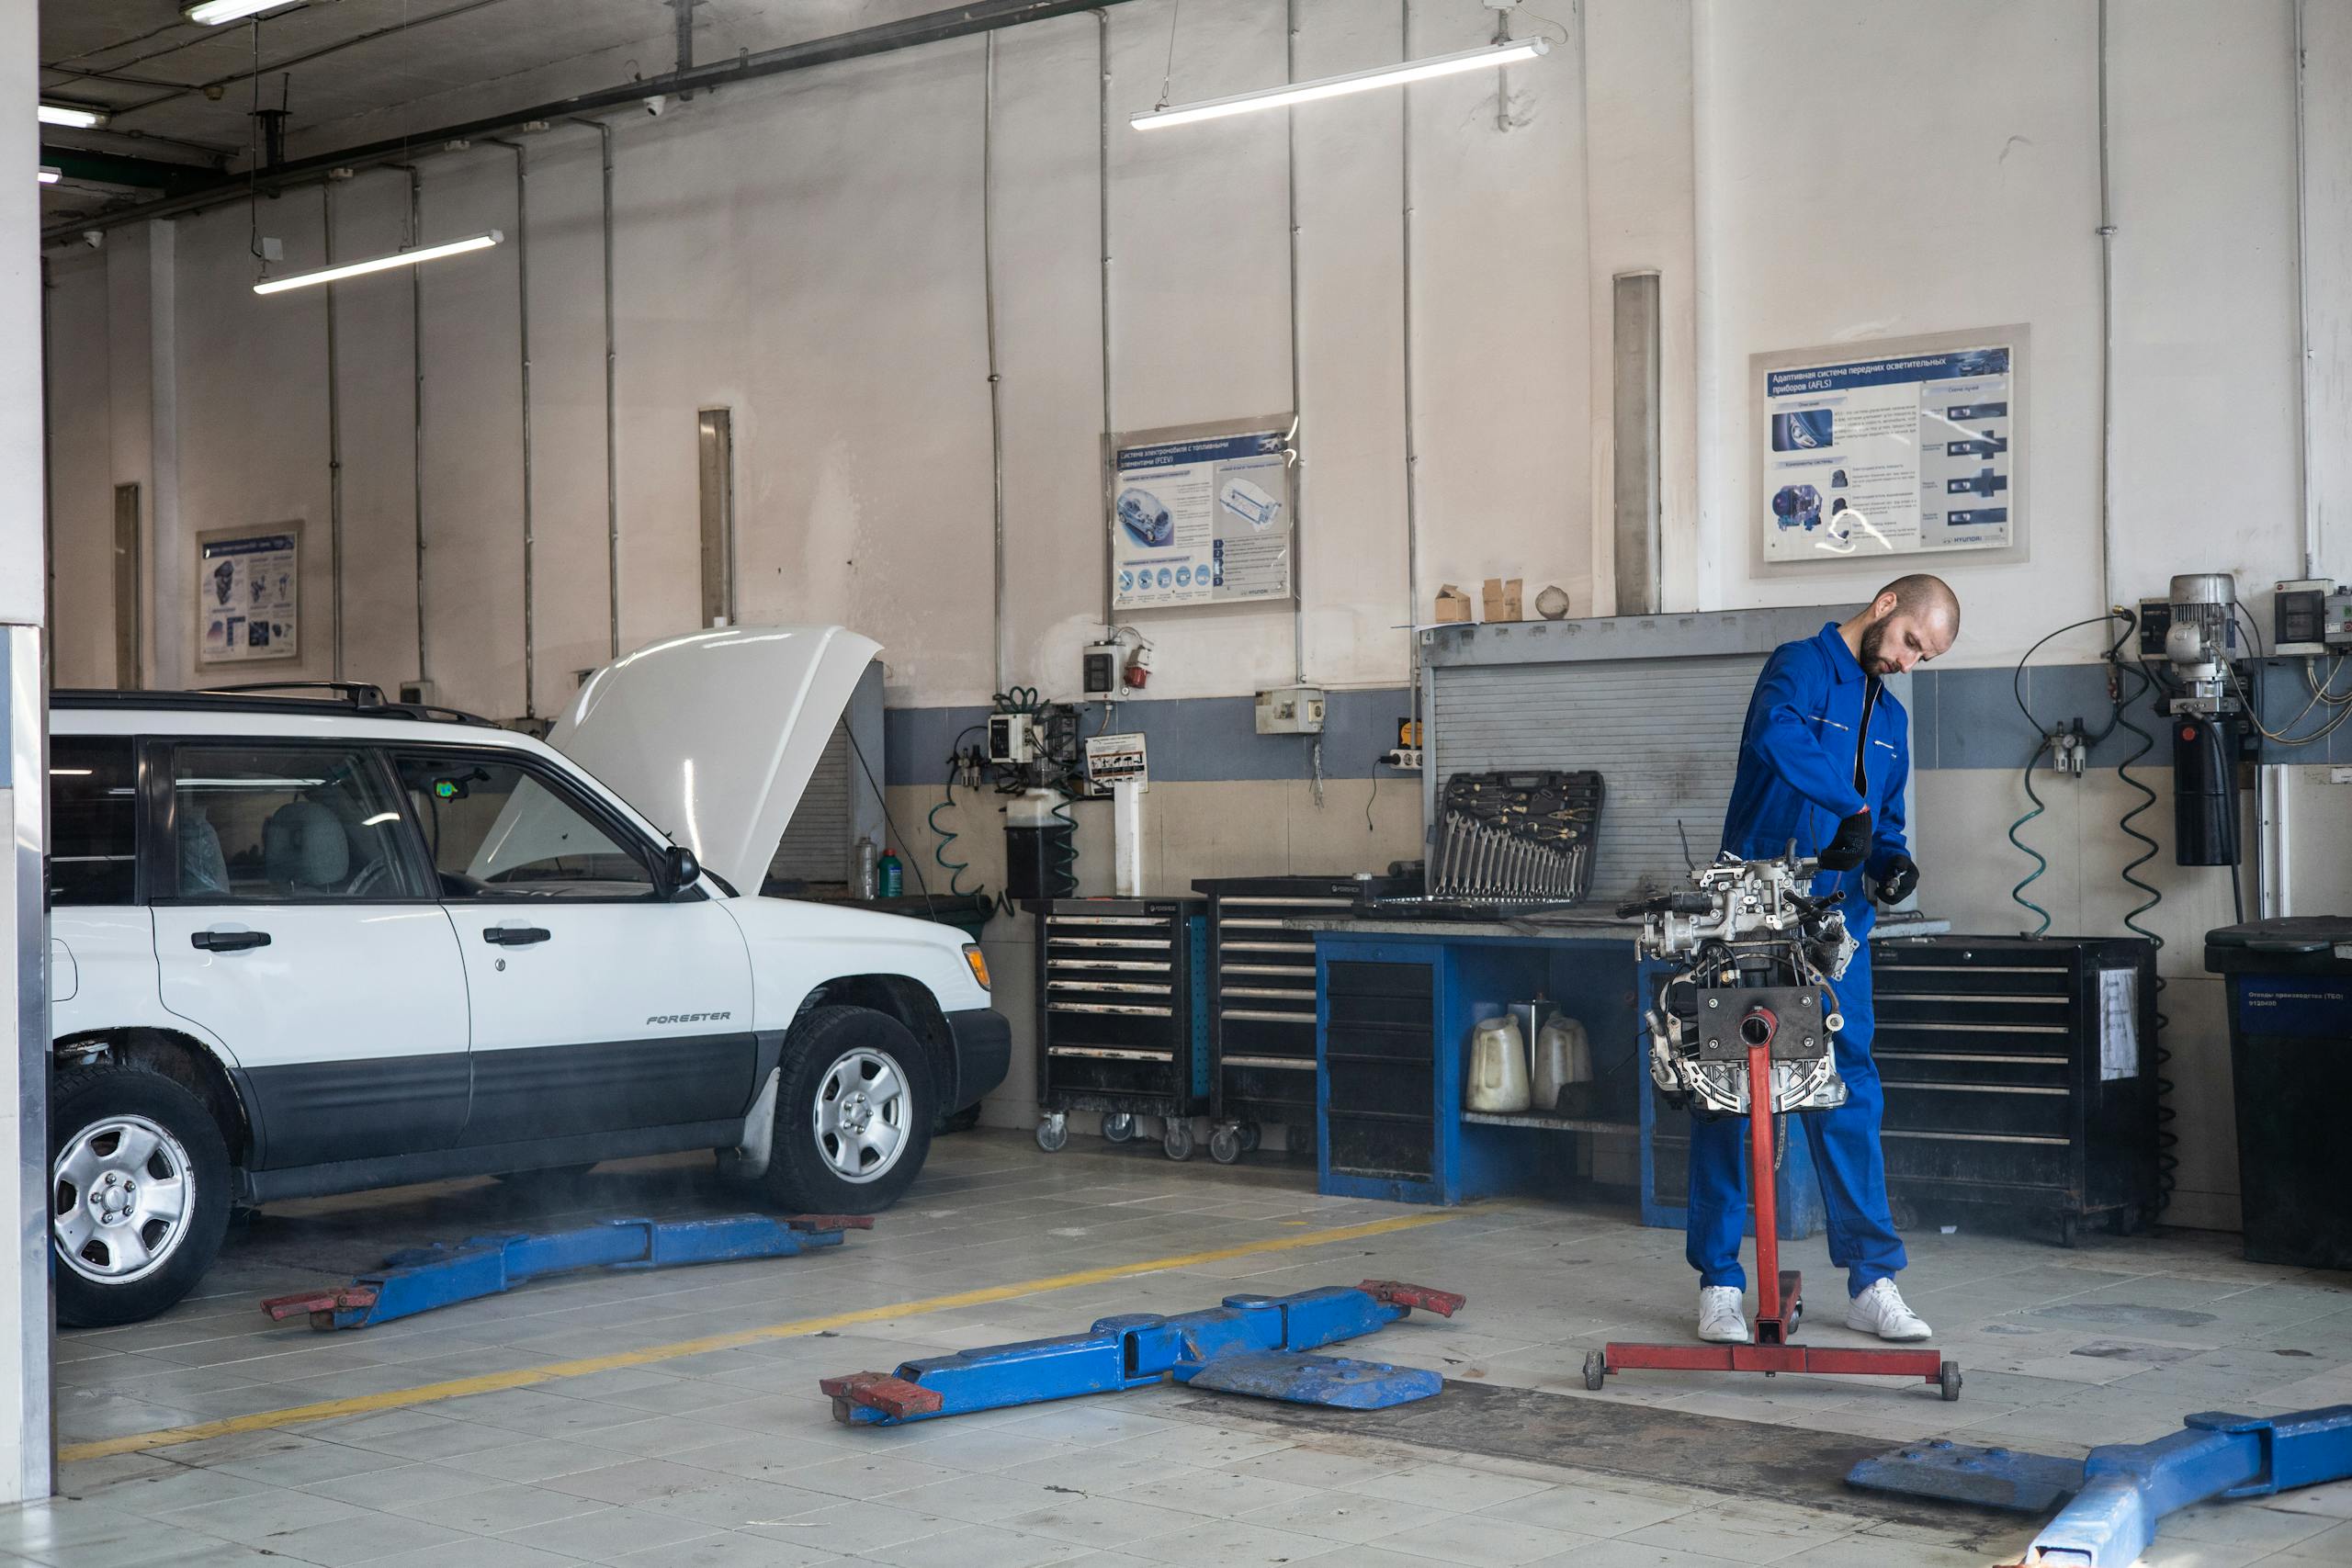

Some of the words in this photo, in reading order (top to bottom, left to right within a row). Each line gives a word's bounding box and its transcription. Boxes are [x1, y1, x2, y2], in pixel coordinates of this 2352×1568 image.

[1772, 371, 1816, 383] Адаптивная
[1817, 368, 1847, 378] система
[1849, 364, 1884, 376] передних
[1886, 357, 1947, 371] осветительных
[1772, 383, 1806, 394] приборов
[1808, 378, 1832, 389] (AFLS)
[1426, 632, 1430, 641] 4
[646, 1011, 731, 1025] FORESTER
